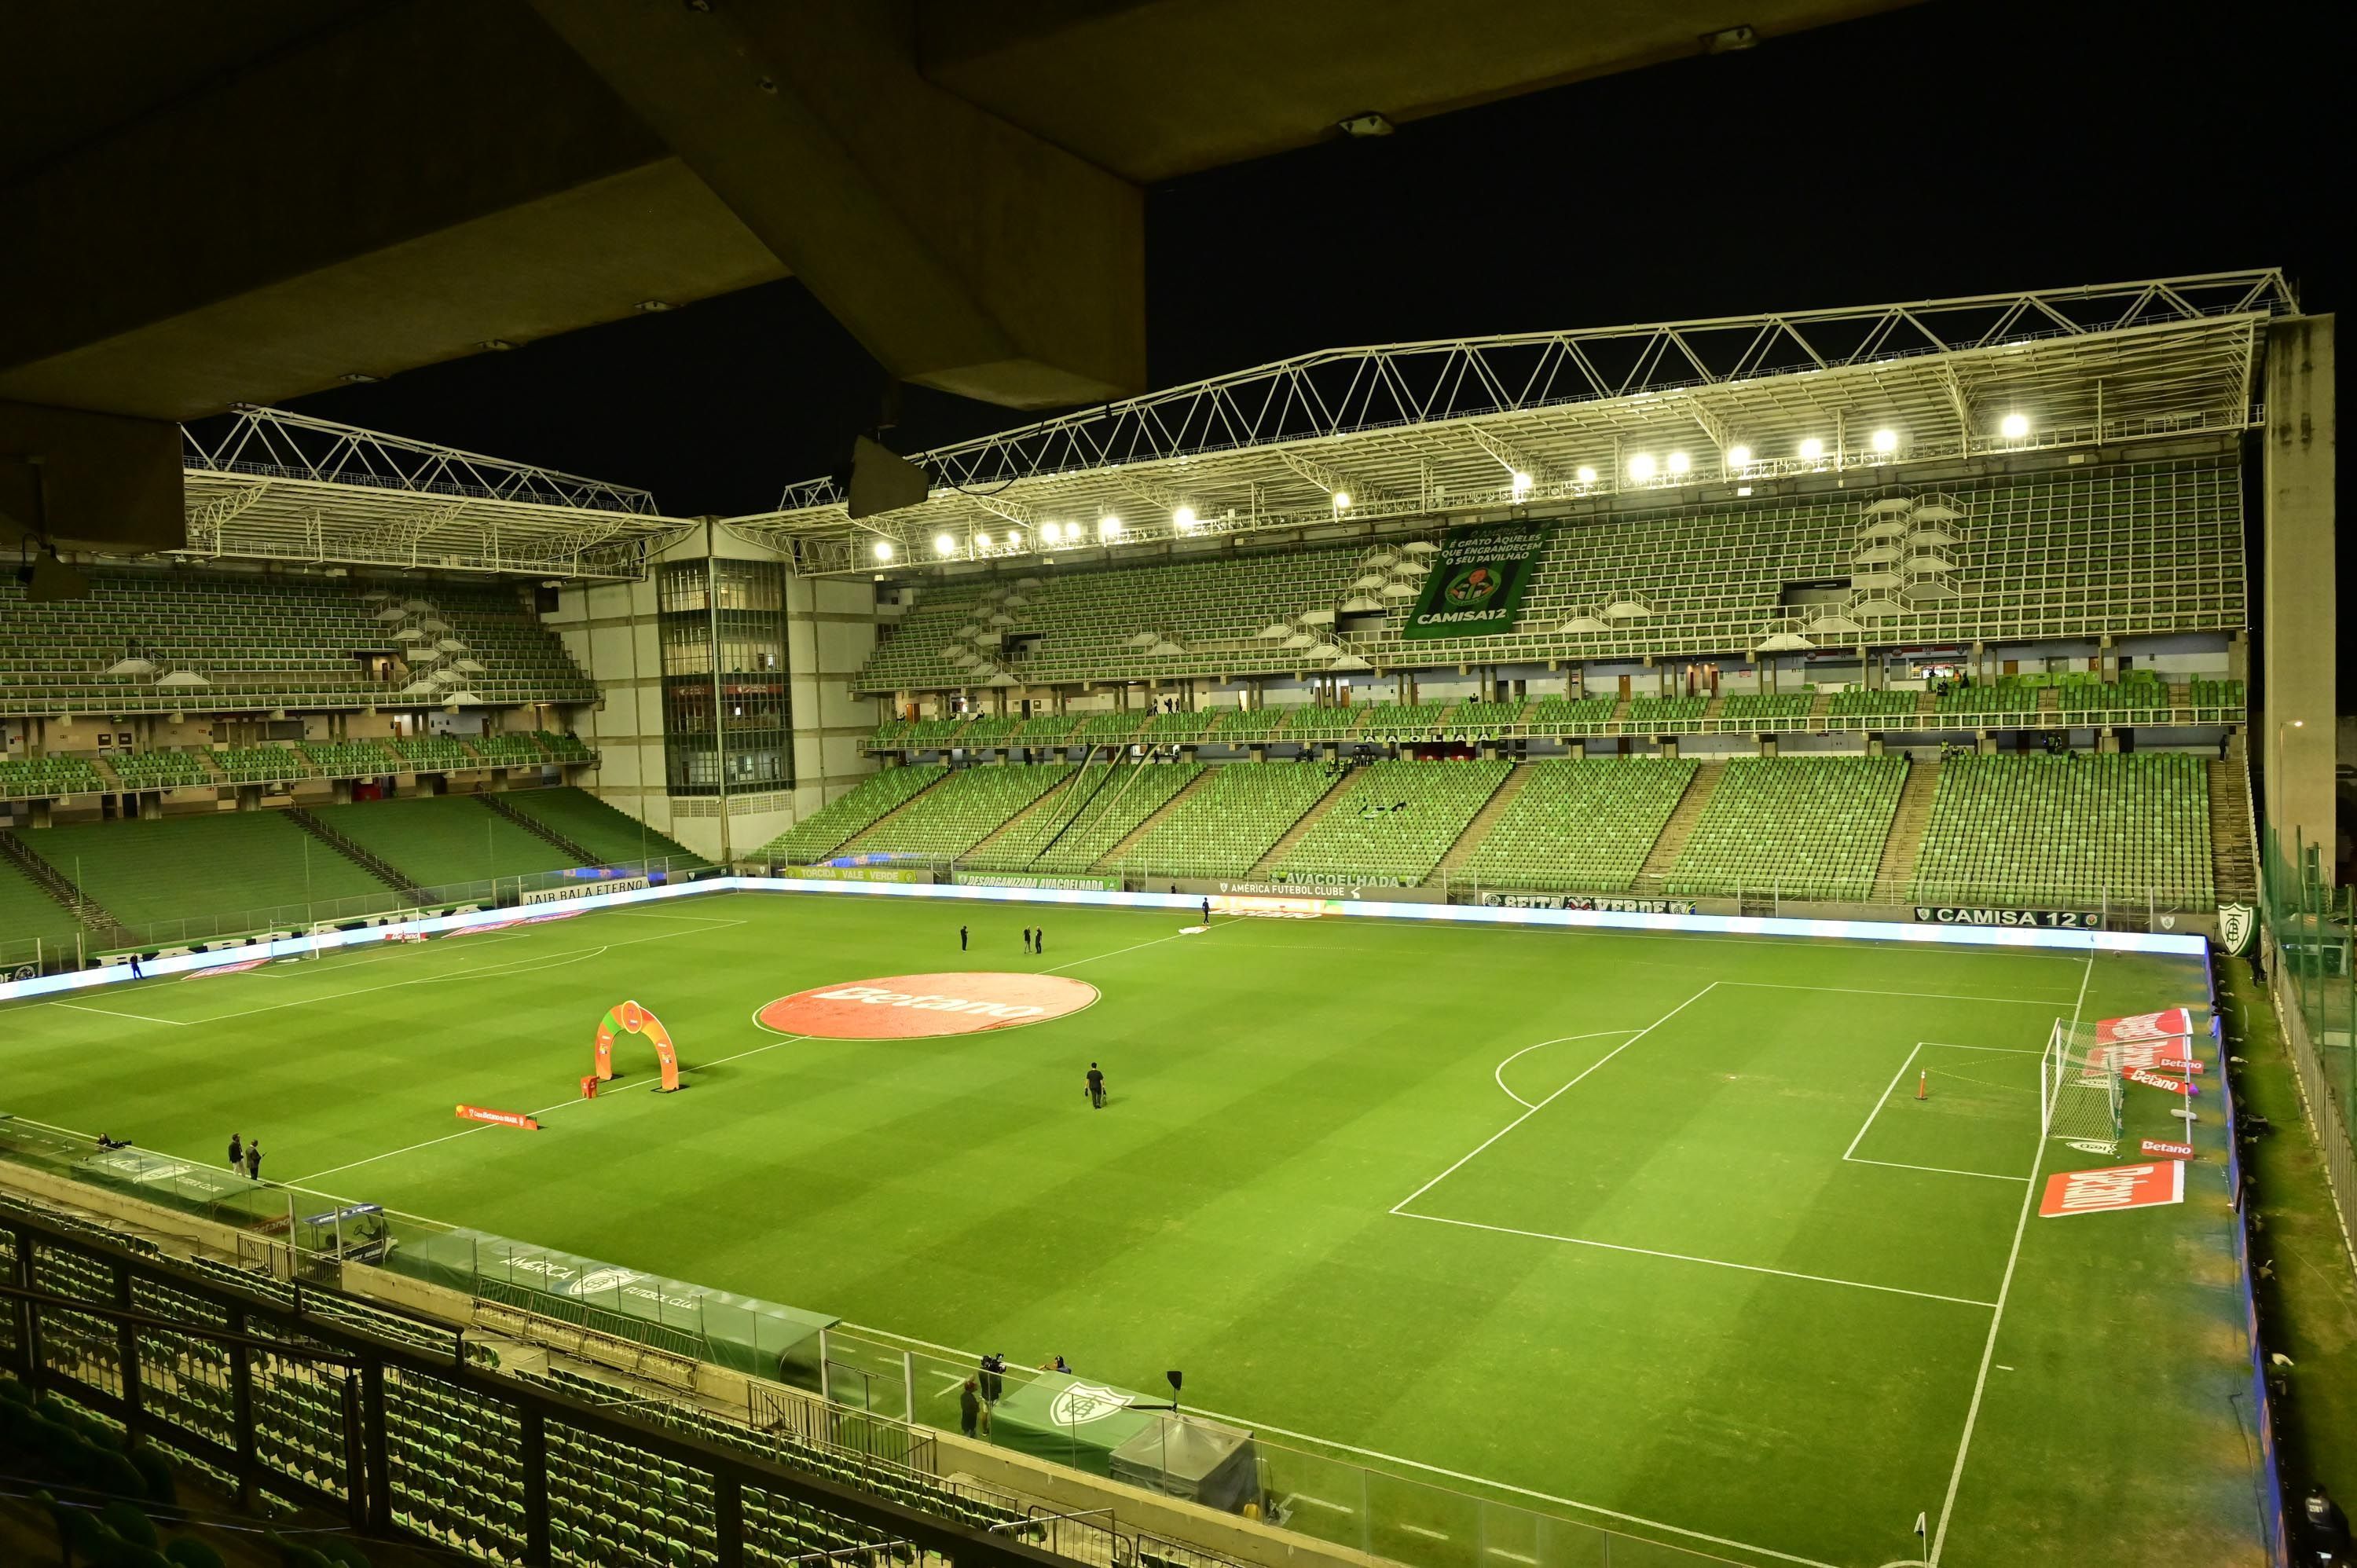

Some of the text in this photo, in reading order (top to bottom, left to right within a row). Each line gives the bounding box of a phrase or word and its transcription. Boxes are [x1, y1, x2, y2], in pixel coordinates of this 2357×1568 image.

[1449, 533, 1541, 548] É GRATO ÀQUELES
[1442, 541, 1543, 559] QUE ENGRANDECEM
[1446, 551, 1530, 566] O SEU PAVILHÃO
[1365, 734, 1490, 743] AVACOELHADA
[801, 869, 898, 881] TORCIDA VALE VERDE
[1285, 873, 1400, 888] AVACOELHADA
[967, 875, 1104, 891] DESORGANIZADA AVACOELHADA
[1231, 881, 1345, 896] AMÉRICA FUTEBOL CLUBE
[526, 892, 555, 906] JAIR
[597, 880, 643, 896] ETERNO
[1937, 908, 2077, 927] CAMISA 12
[811, 987, 1044, 1018] Betano
[2161, 1058, 2202, 1068] Betano
[2130, 1069, 2179, 1090] Betano
[2142, 1141, 2191, 1155] Betano
[2062, 1166, 2154, 1208] Betano
[622, 1287, 669, 1302] FUTEBOL
